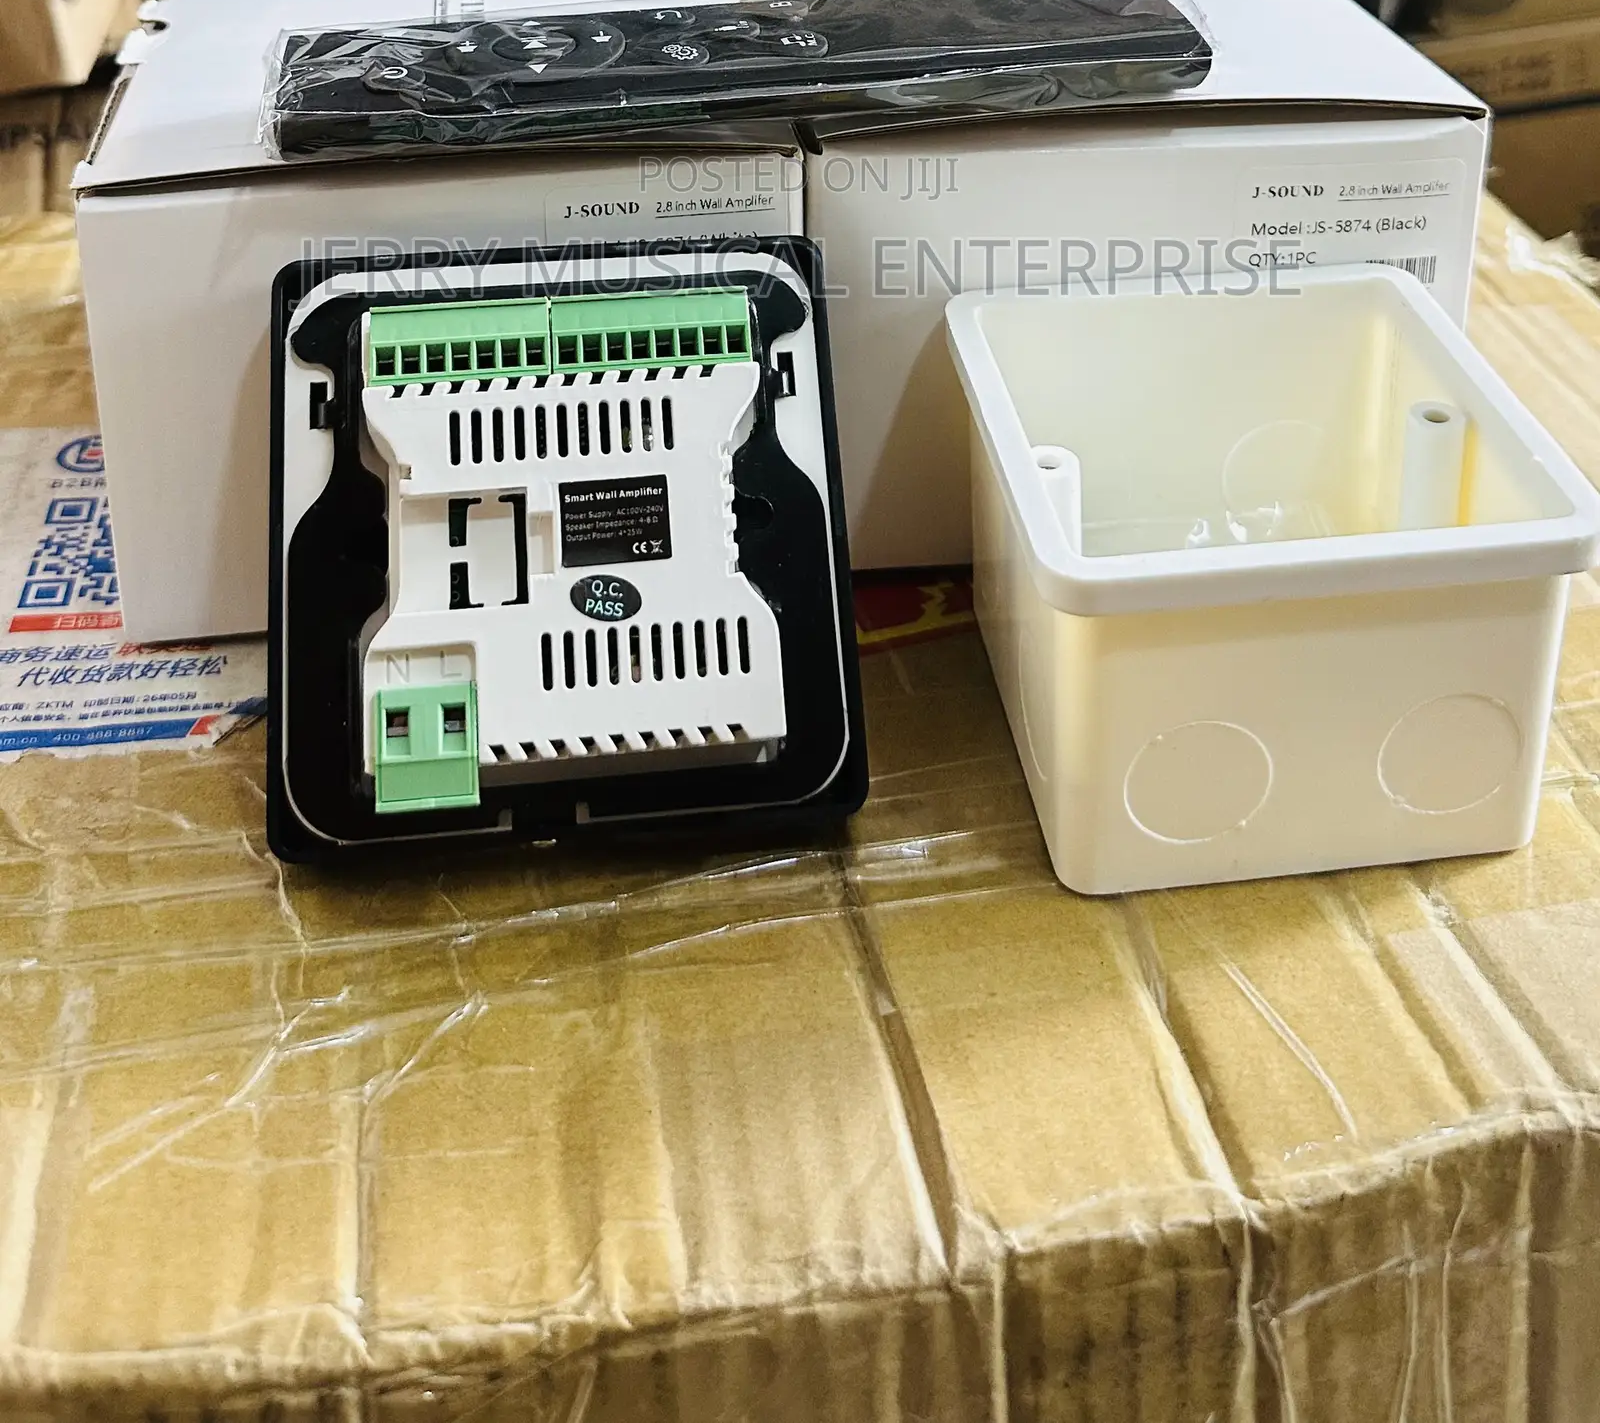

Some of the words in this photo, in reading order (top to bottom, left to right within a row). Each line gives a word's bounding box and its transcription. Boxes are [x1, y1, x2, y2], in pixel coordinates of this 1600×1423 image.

[1251, 185, 1325, 200] J-SOUND
[1338, 185, 1356, 197] 2.8
[1356, 184, 1379, 196] inch
[1381, 183, 1402, 195] Wall
[1404, 180, 1450, 195] Amplifer
[563, 201, 640, 219] J-SOUND
[655, 201, 673, 213] 2.8
[675, 200, 697, 212] inch
[699, 198, 722, 211] Wall
[725, 194, 773, 210] Amplifer
[1375, 215, 1428, 235] (Black)
[1248, 251, 1318, 269] QTY:1PC
[564, 492, 594, 504] Smart
[595, 490, 617, 501] Wall
[618, 486, 663, 499] Amplifier
[565, 513, 587, 521] Power
[565, 522, 595, 532] Speaker
[565, 533, 592, 543] Output
[591, 579, 624, 598] Q.C.
[585, 598, 625, 618] PASS
[17, 654, 228, 688] 代收货款好轻松
[384, 652, 411, 684] N
[440, 651, 463, 678] L
[36, 700, 74, 710] ZKTM
